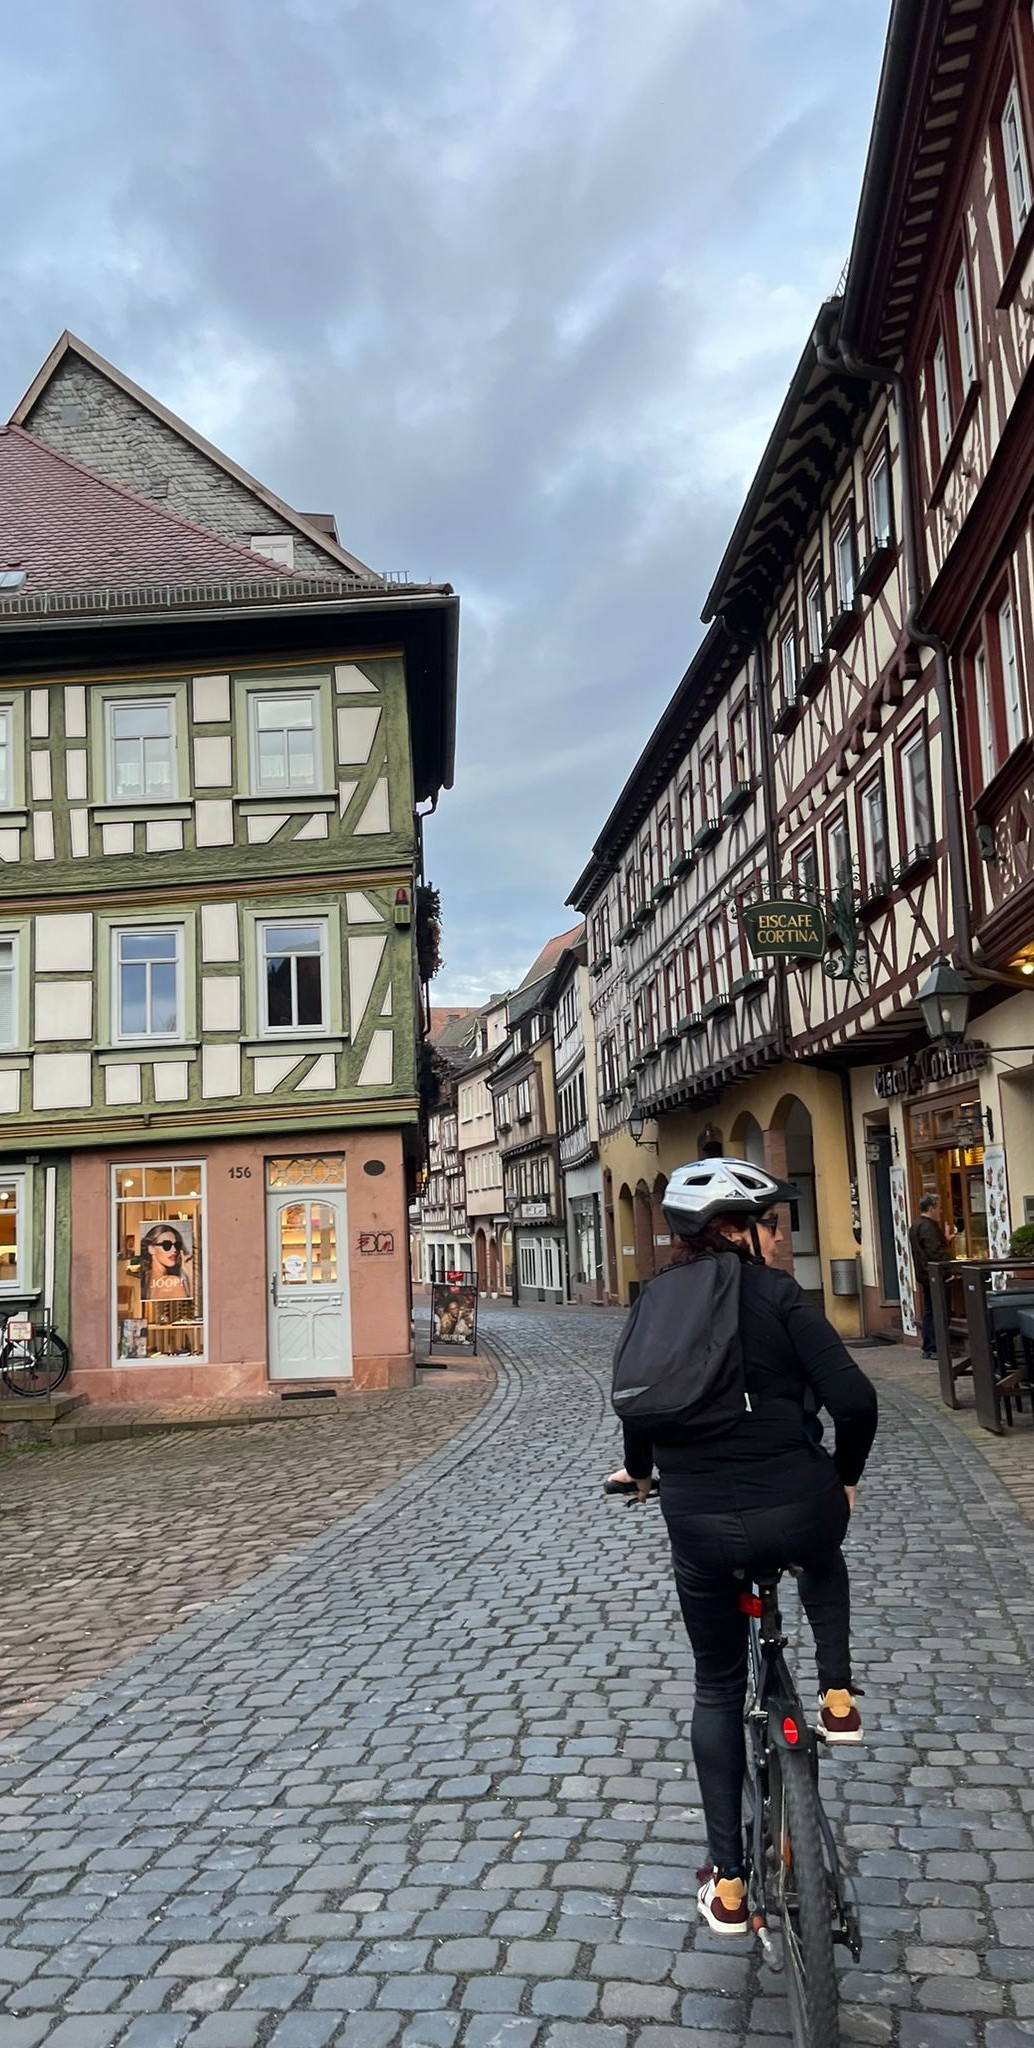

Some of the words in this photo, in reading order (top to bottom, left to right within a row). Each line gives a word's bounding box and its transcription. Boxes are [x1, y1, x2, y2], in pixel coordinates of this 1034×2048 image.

[758, 914, 813, 929] EISCAFE
[757, 929, 819, 944] CORTINA
[228, 1166, 252, 1179] 156
[150, 1278, 184, 1289] JOOP!
